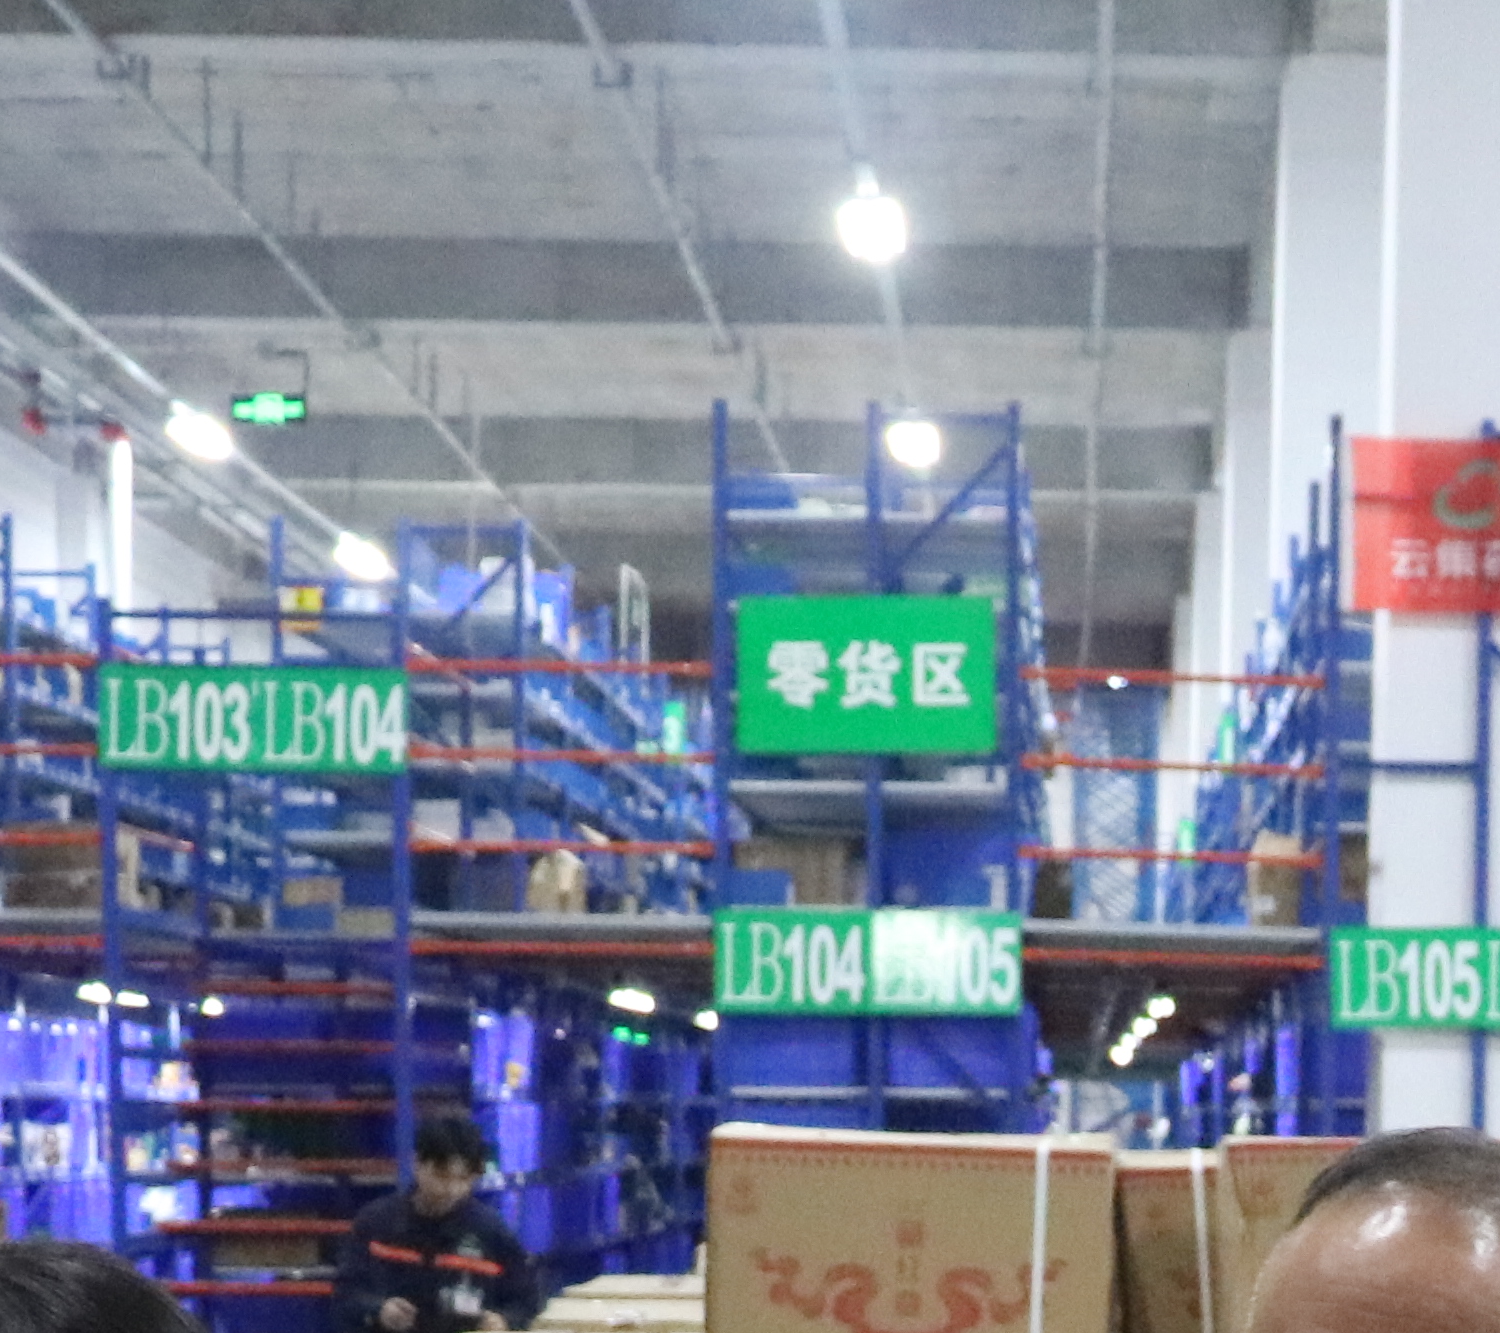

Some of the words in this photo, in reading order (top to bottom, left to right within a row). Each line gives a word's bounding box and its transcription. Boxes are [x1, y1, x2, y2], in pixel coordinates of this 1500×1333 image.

[766, 639, 971, 709] 零货区
[105, 677, 251, 764] LB103
[261, 680, 408, 765] LB104
[719, 921, 866, 1006] LB104
[1339, 938, 1481, 1021] LB105
